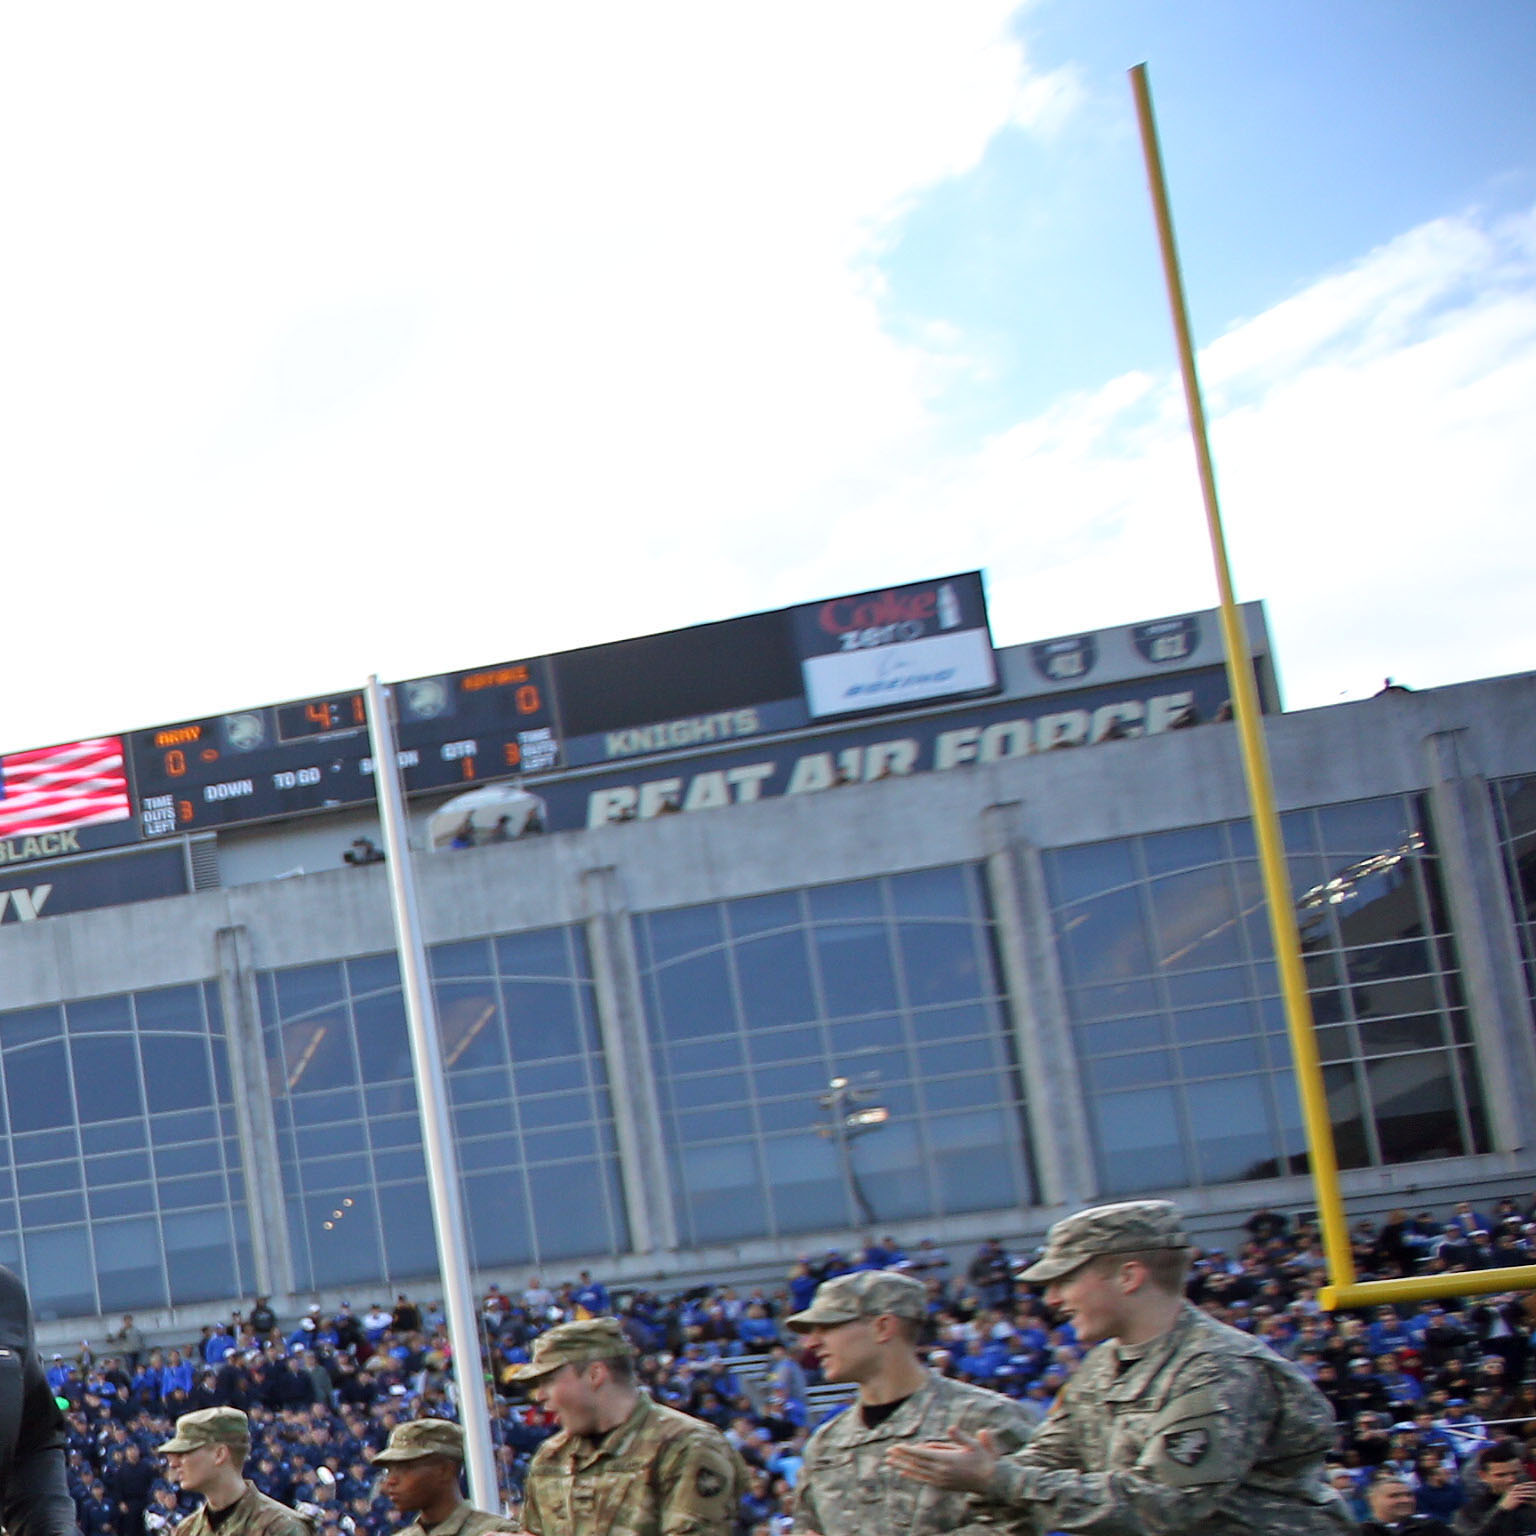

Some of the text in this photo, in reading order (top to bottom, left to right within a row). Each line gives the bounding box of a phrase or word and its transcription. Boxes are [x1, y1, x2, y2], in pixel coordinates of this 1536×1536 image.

[818, 587, 939, 635] Coke
[514, 685, 540, 715] 0
[604, 708, 759, 758] KNIGHTS
[164, 749, 186, 777] 0
[783, 736, 919, 795] AIR
[203, 779, 253, 802] DOWN
[272, 766, 321, 790] TO GO
[142, 794, 173, 810] TIME
[586, 761, 777, 828] BEAT
[178, 800, 194, 823] 3
[144, 820, 176, 836] LEFT
